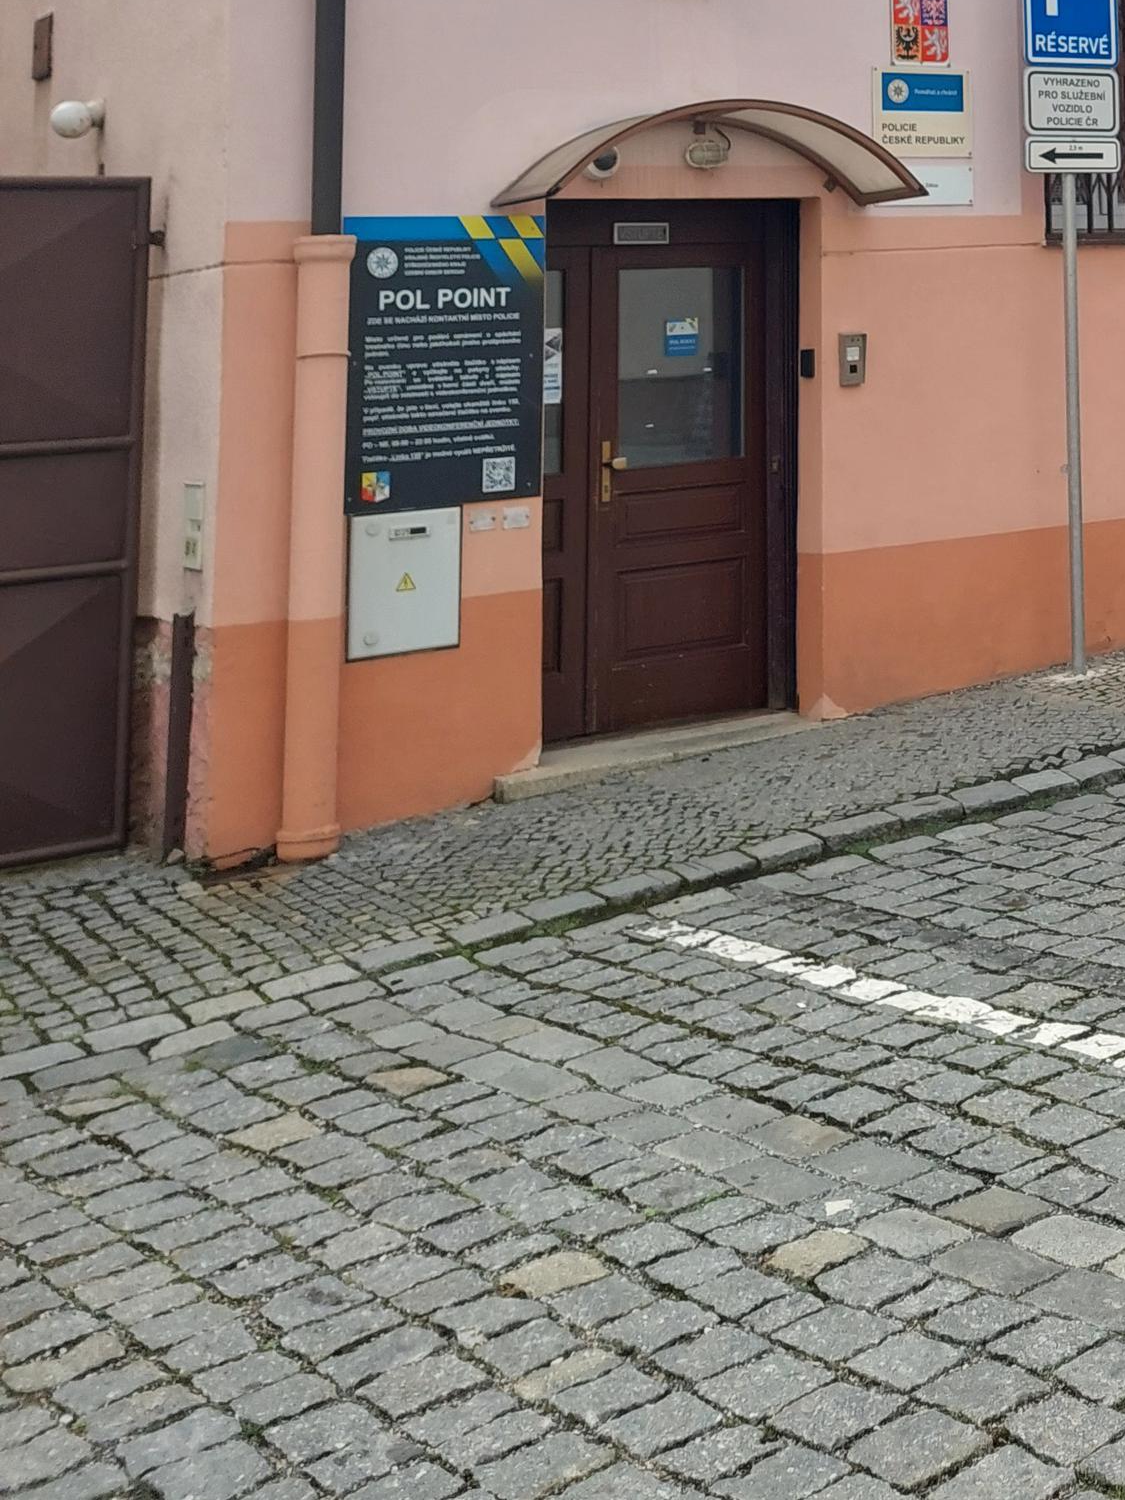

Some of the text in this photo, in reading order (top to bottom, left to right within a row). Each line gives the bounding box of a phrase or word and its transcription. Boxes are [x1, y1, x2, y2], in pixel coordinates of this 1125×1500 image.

[1035, 30, 1109, 55] RÉSERVÉ
[1043, 77, 1100, 88] VYHRAZENO
[1038, 90, 1106, 101] PRO SLUŽEBNÍ
[1051, 103, 1093, 113] VOZIDLO
[1046, 115, 1099, 126] POLICIE ČR
[881, 123, 917, 132] POLICIE
[881, 134, 965, 145] ČESKÉ REPUBLIKY
[379, 287, 511, 311] POL POINT
